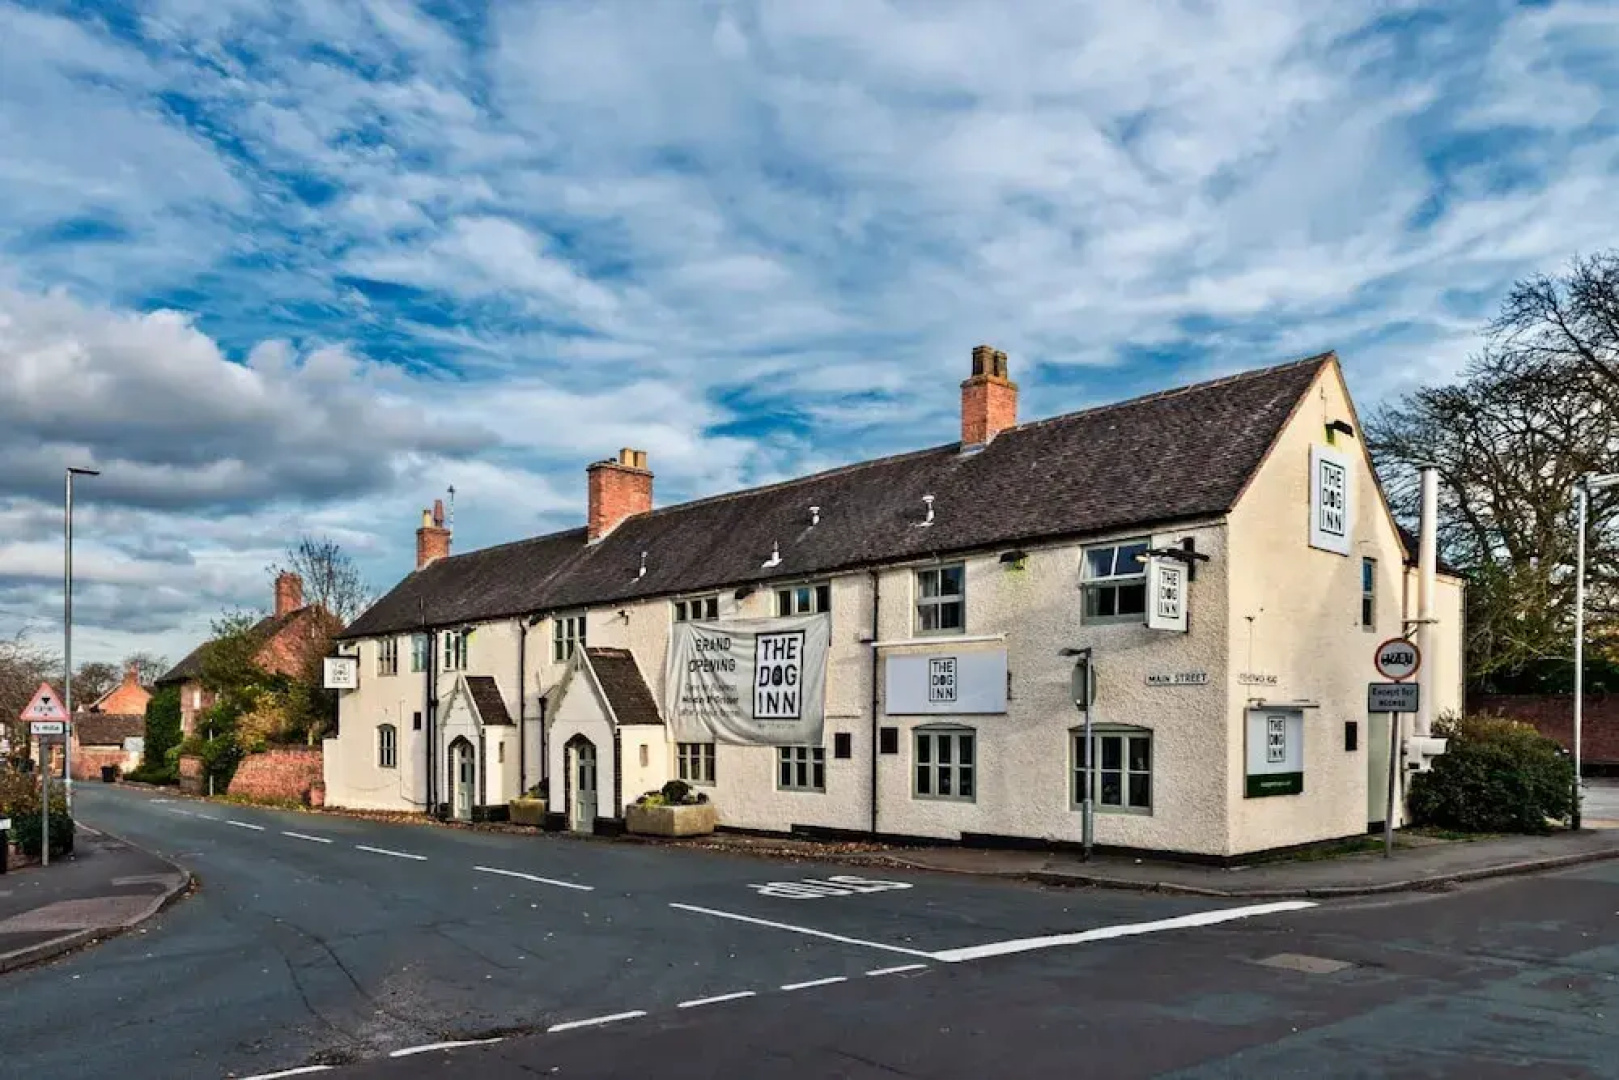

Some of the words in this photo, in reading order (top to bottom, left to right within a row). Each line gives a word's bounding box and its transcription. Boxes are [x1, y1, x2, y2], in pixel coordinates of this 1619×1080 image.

[1323, 465, 1342, 489] THE
[1322, 488, 1342, 510] DOG
[1322, 509, 1342, 532] INN
[1160, 571, 1178, 586] THE
[1160, 586, 1178, 600] DOG
[1160, 601, 1178, 614] INN
[695, 637, 731, 652] GRAND
[761, 637, 799, 661] THE
[688, 658, 736, 673] OPENING
[932, 661, 953, 673] THE
[758, 664, 798, 687] DOG
[932, 674, 953, 686] DOG
[1148, 674, 1170, 683] MAIN
[1174, 673, 1207, 683] STREET
[932, 687, 953, 699] INN
[758, 690, 796, 714] INN
